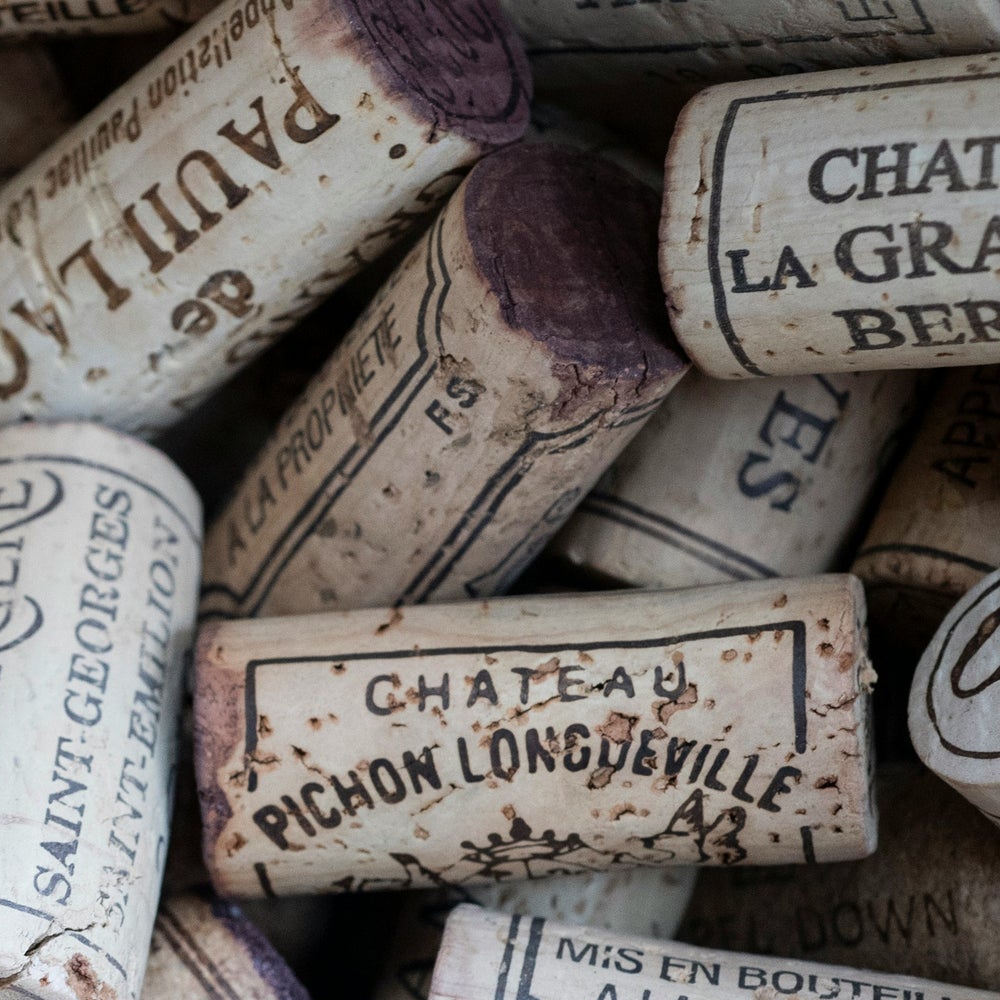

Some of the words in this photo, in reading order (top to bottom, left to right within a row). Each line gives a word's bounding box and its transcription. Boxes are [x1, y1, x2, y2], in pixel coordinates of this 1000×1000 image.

[725, 245, 817, 292] LA
[171, 268, 256, 338] de
[365, 660, 689, 716] CHATEAU
[253, 747, 441, 850] PICHON
[556, 937, 645, 975] MIS
[660, 956, 720, 986] EN
